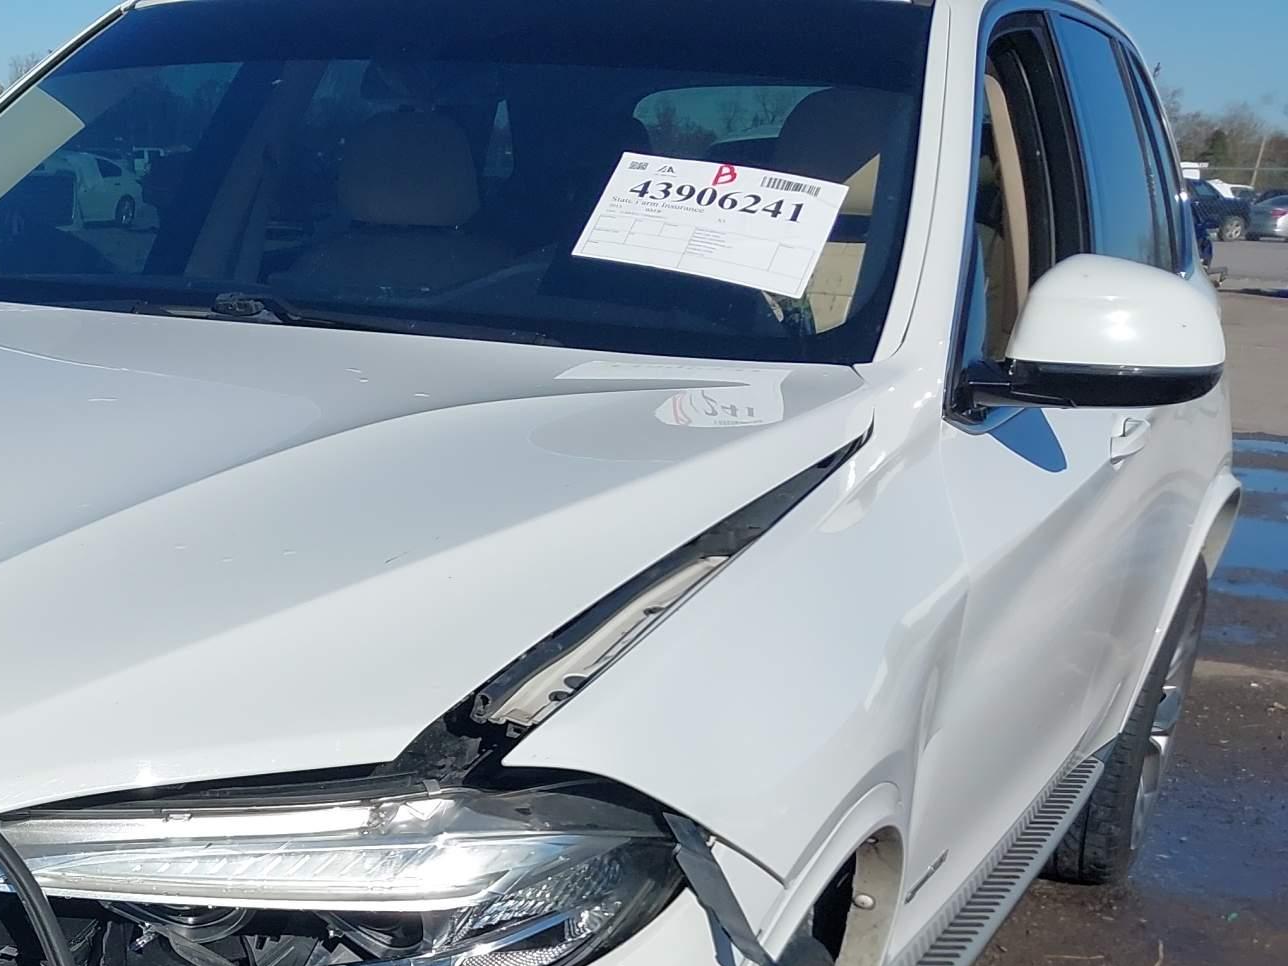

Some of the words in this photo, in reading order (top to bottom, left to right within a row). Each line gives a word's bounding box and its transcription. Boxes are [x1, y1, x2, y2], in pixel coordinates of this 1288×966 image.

[712, 163, 737, 187] B
[629, 179, 804, 223] 43906241
[660, 201, 705, 213] Insurance
